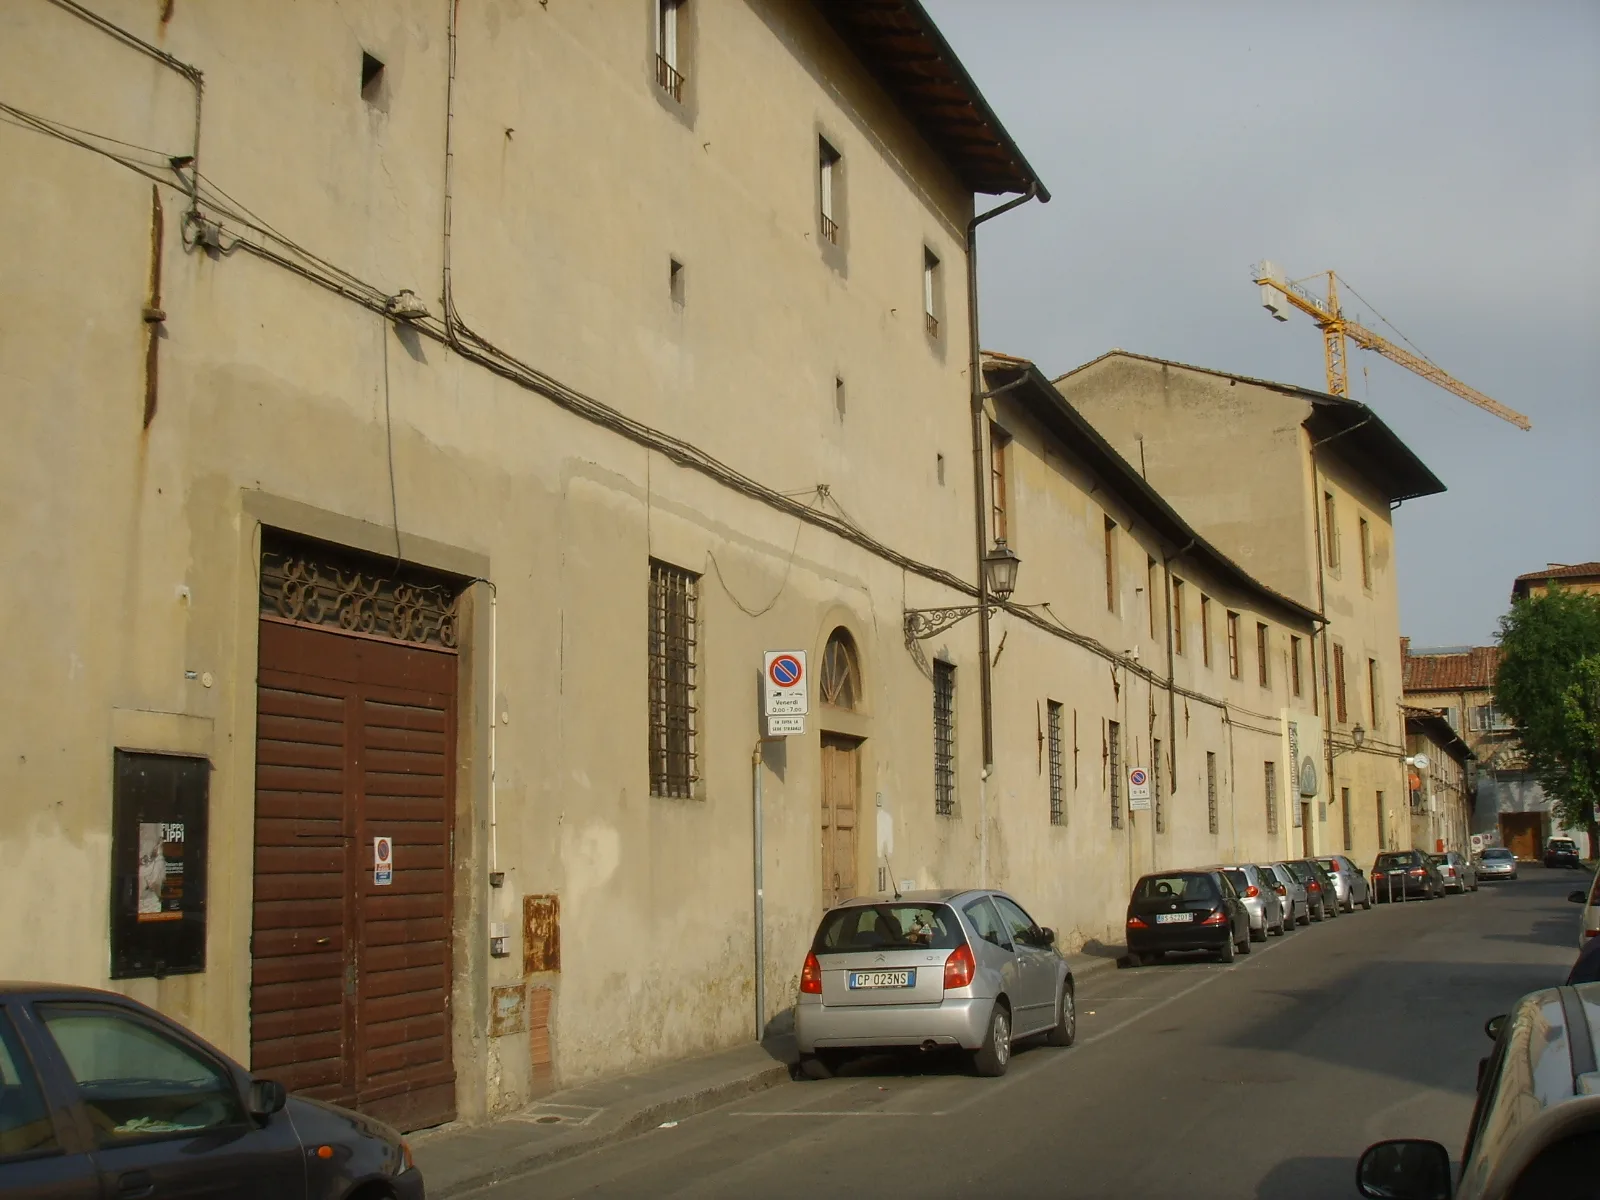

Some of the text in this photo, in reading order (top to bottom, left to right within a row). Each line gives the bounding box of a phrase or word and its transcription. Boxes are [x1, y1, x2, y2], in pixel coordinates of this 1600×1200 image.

[161, 823, 184, 831] FILIPPO
[161, 831, 184, 842] LIPPI
[857, 973, 907, 986] CP 023NS
